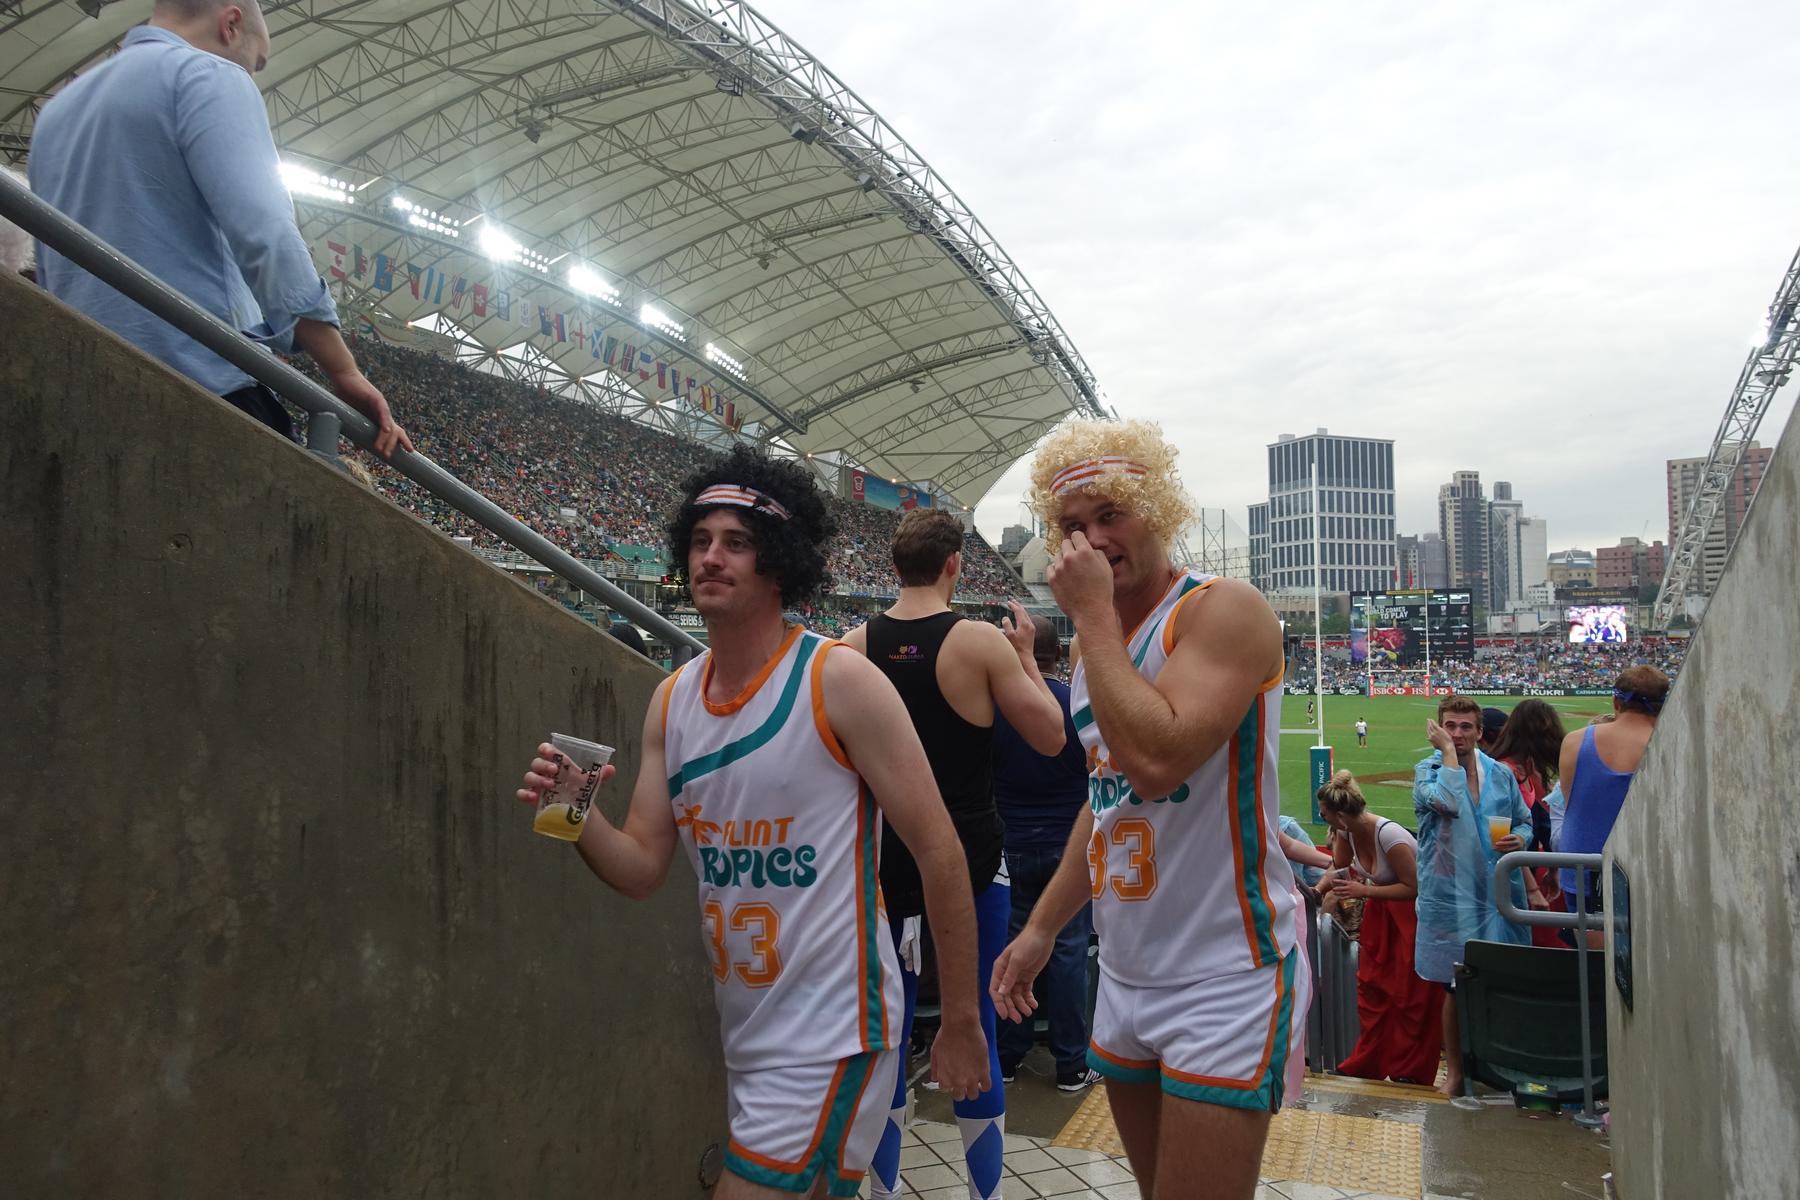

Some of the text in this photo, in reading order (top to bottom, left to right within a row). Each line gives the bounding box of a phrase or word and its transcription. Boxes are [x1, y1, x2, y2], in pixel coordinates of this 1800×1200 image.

[1391, 611, 1408, 619] PLAY
[680, 614, 698, 626] SEVENS
[1457, 687, 1505, 695] hksevens.com
[1530, 688, 1565, 696] KUKRI
[566, 761, 602, 826] Carlsberg
